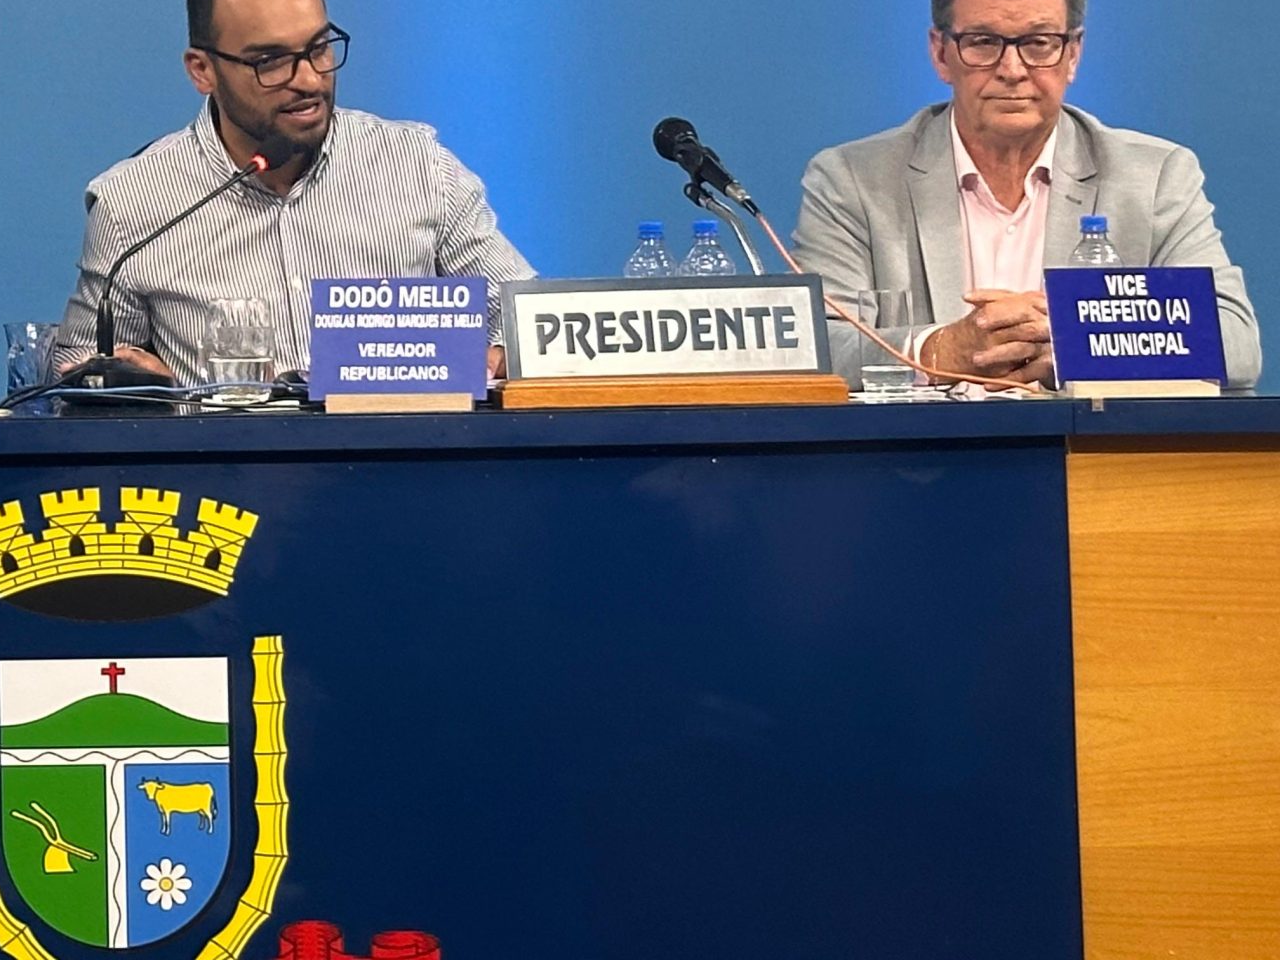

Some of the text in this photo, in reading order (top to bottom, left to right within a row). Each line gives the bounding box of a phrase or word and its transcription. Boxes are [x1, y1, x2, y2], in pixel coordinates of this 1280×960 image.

[329, 279, 470, 309] DODÔ MELLO
[1104, 274, 1149, 296] VICE
[315, 314, 356, 328] DOUGLAS
[440, 314, 453, 328] DE
[454, 314, 483, 328] MELLO
[1077, 298, 1191, 325] PREFEITO (A)
[535, 306, 799, 360] PRESIDENTE
[1088, 332, 1190, 356] MUNICIPAL
[358, 343, 436, 358] VEREADOR
[340, 366, 448, 381] REPUBLICANOS
